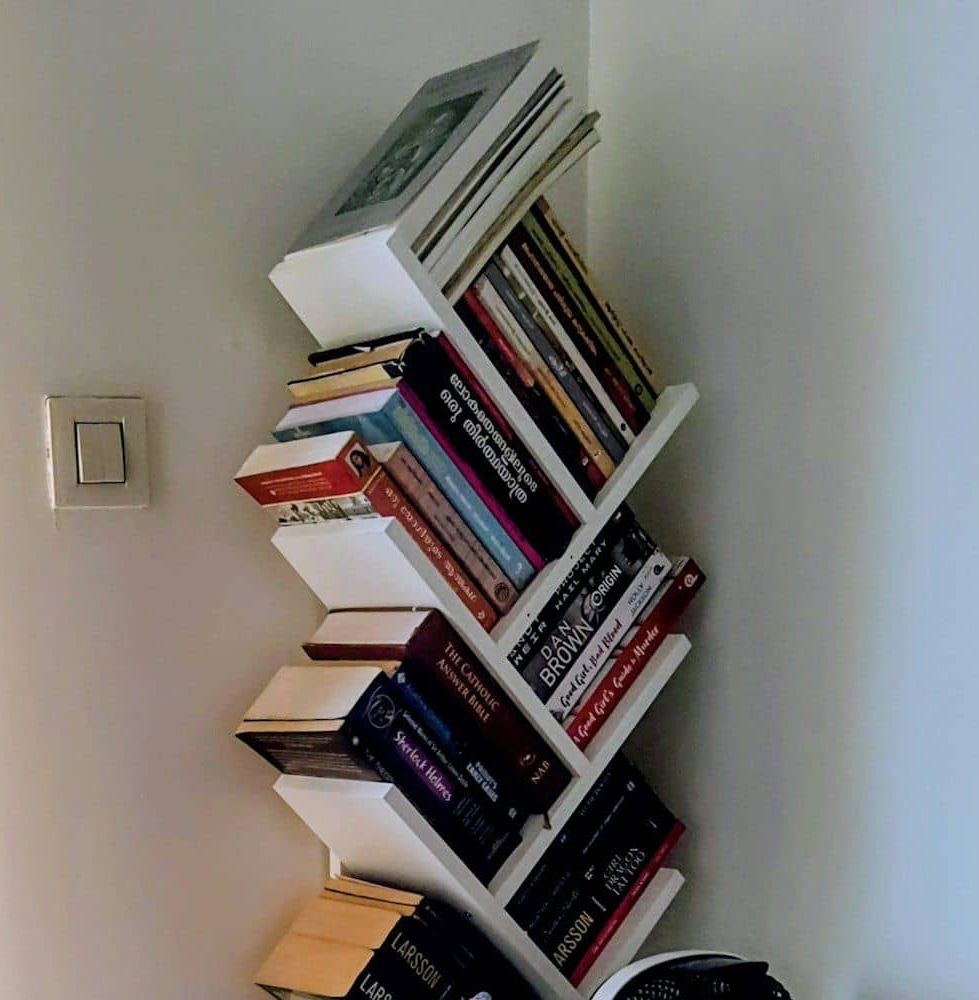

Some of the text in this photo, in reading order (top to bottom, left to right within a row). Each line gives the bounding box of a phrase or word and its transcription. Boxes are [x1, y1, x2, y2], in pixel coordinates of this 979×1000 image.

[438, 387, 463, 422] ഒരു
[555, 539, 605, 610] HAIL MARY
[588, 563, 622, 607] ORIGIN
[513, 620, 546, 665] WEIR
[539, 619, 570, 659] DAN
[539, 616, 593, 687] BROWN
[558, 682, 579, 707] Good
[587, 644, 606, 667] Bad
[600, 618, 623, 648] Blood
[435, 659, 491, 723] ANSWER BIBLE
[443, 640, 502, 713] THE CATHOLIC
[575, 711, 597, 737] Good
[610, 660, 631, 688] Guide
[632, 624, 660, 660] Murder
[393, 730, 430, 772] Sherlock
[423, 766, 453, 802] Holmes
[390, 933, 442, 989] LARSSON
[551, 909, 595, 966] ARSSON
